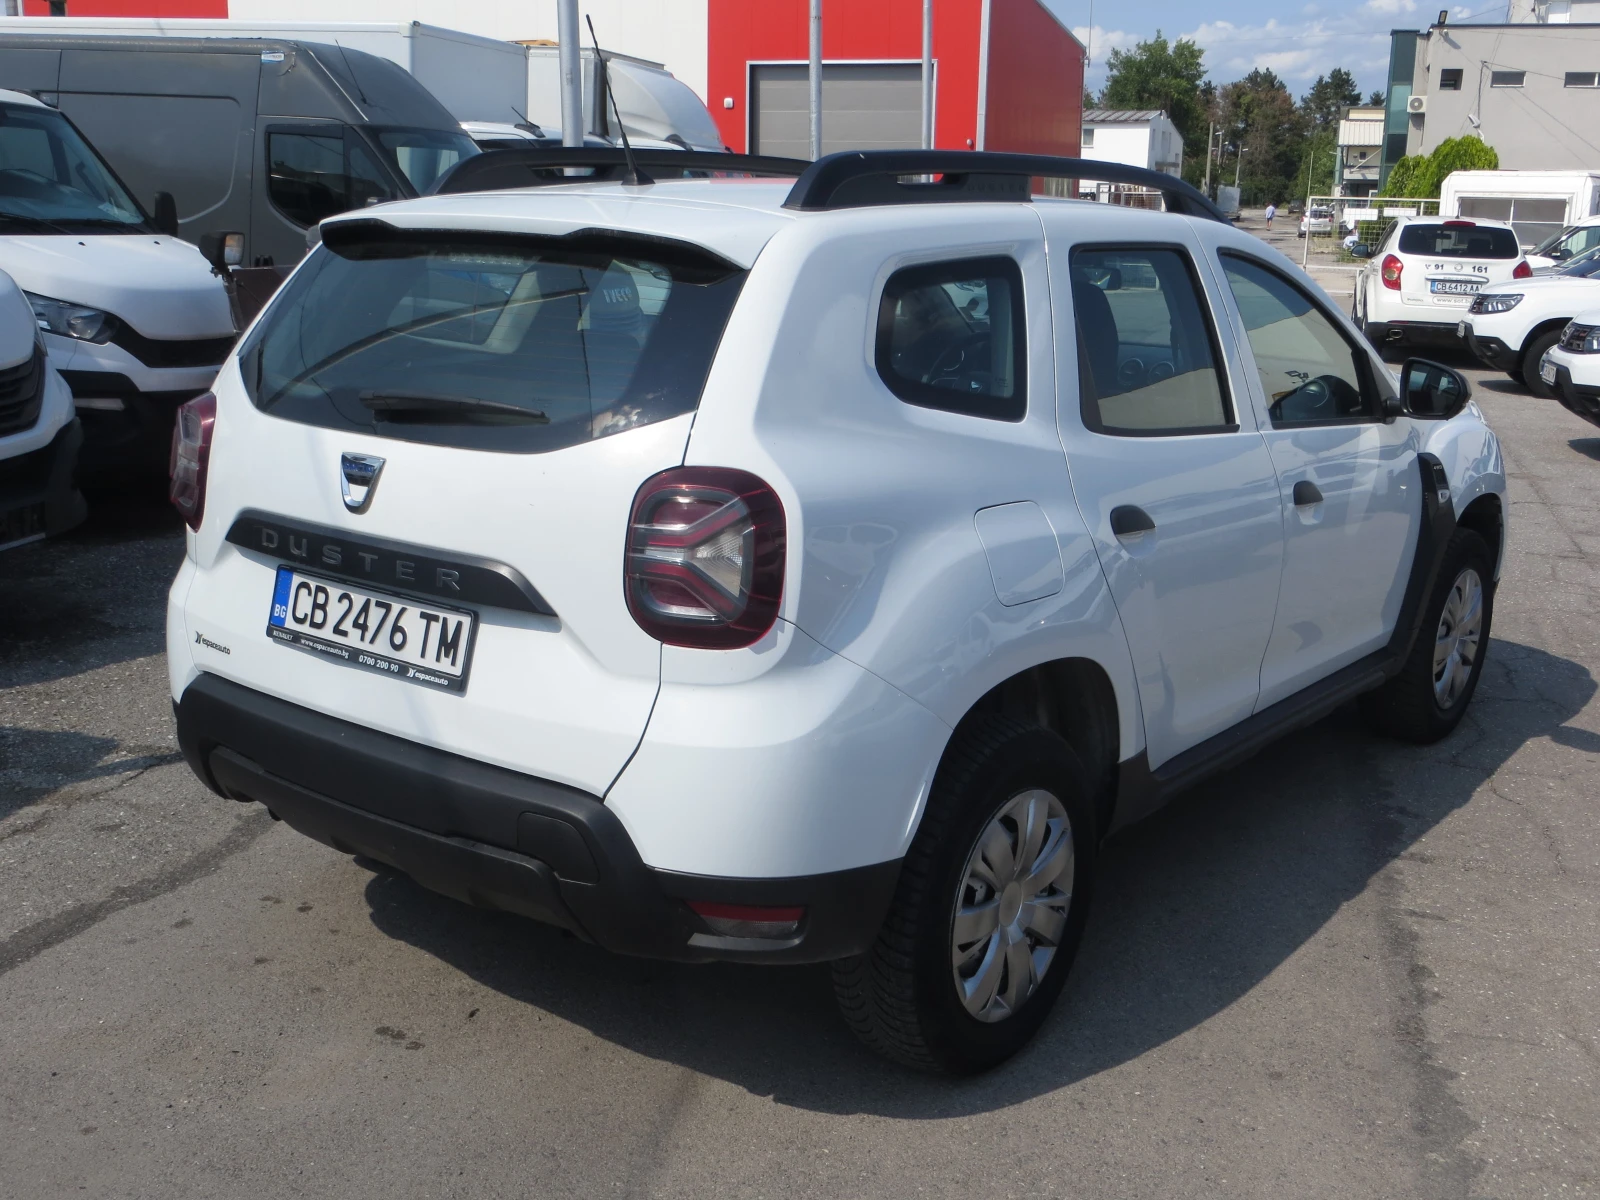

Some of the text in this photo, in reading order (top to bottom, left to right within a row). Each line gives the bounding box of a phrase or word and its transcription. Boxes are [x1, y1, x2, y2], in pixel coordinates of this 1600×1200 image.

[1472, 265, 1488, 273] 161
[1436, 282, 1447, 291] CB
[261, 527, 461, 591] DUSTER
[273, 605, 287, 619] BG
[291, 581, 465, 668] CB 2476 TM
[202, 637, 231, 655] espaceauto
[272, 630, 449, 686] RENAULT www.espaceauto.bg 0700 200 90 espaceauto
